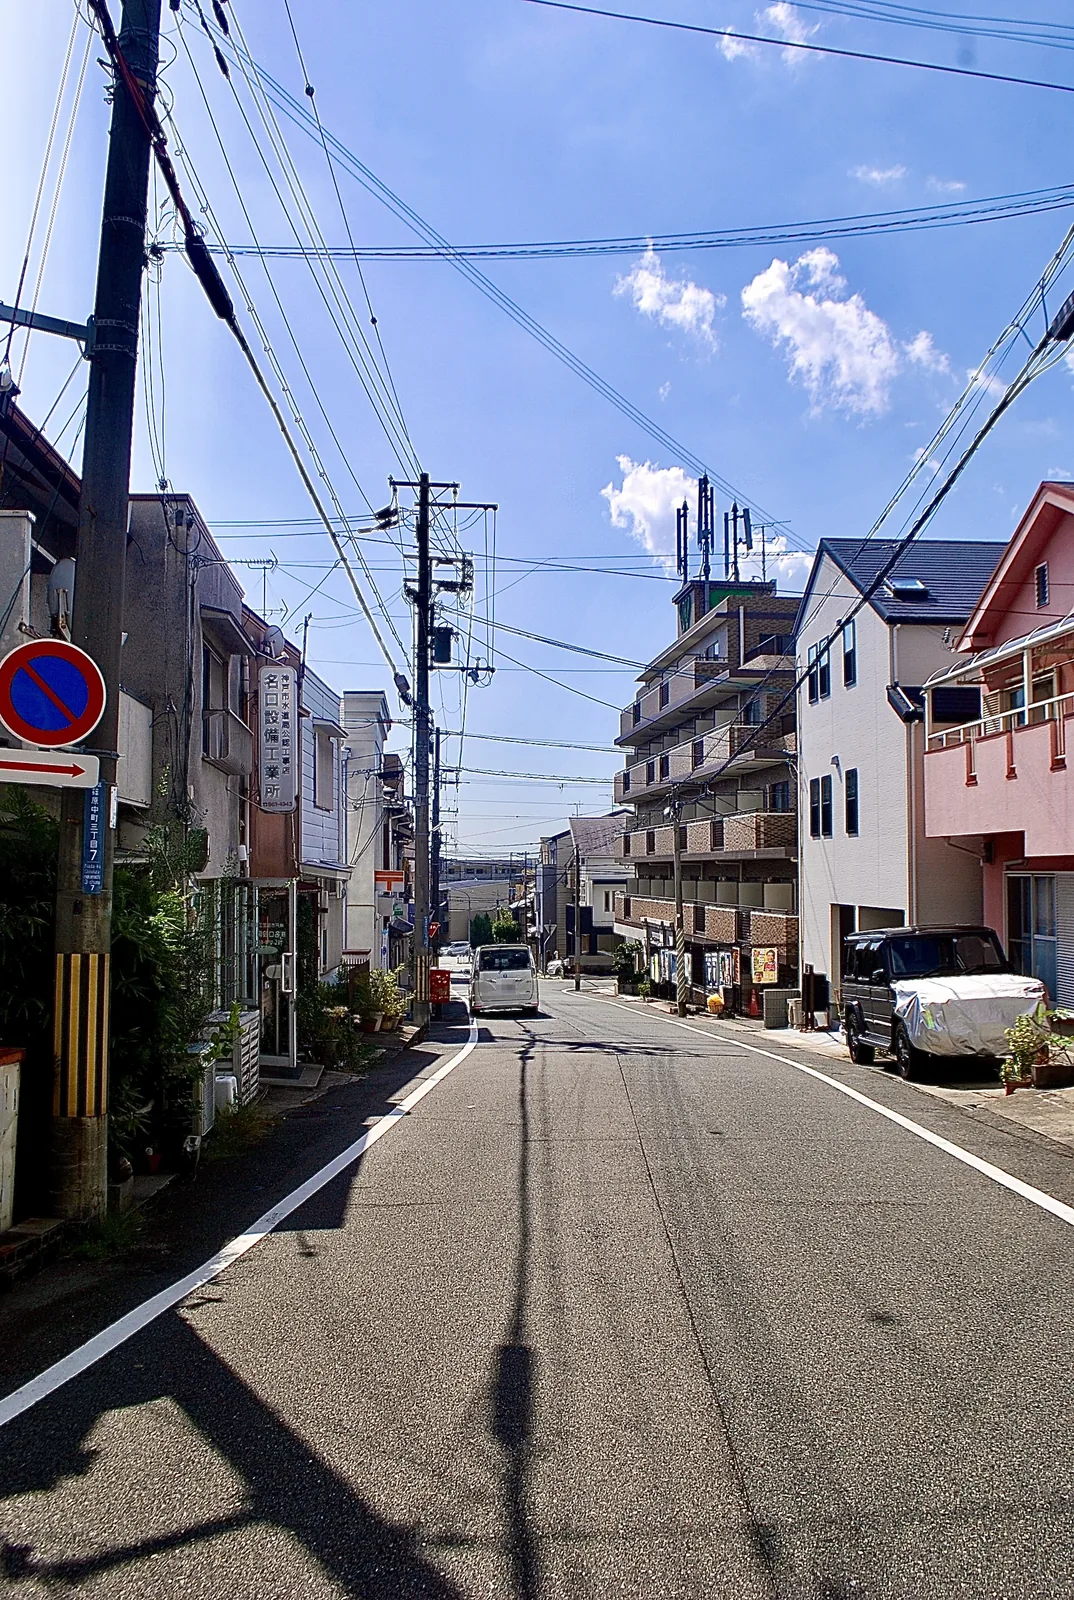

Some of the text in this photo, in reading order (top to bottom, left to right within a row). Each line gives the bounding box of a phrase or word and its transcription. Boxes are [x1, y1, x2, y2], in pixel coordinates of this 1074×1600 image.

[264, 673, 280, 798] 名口設備工業所
